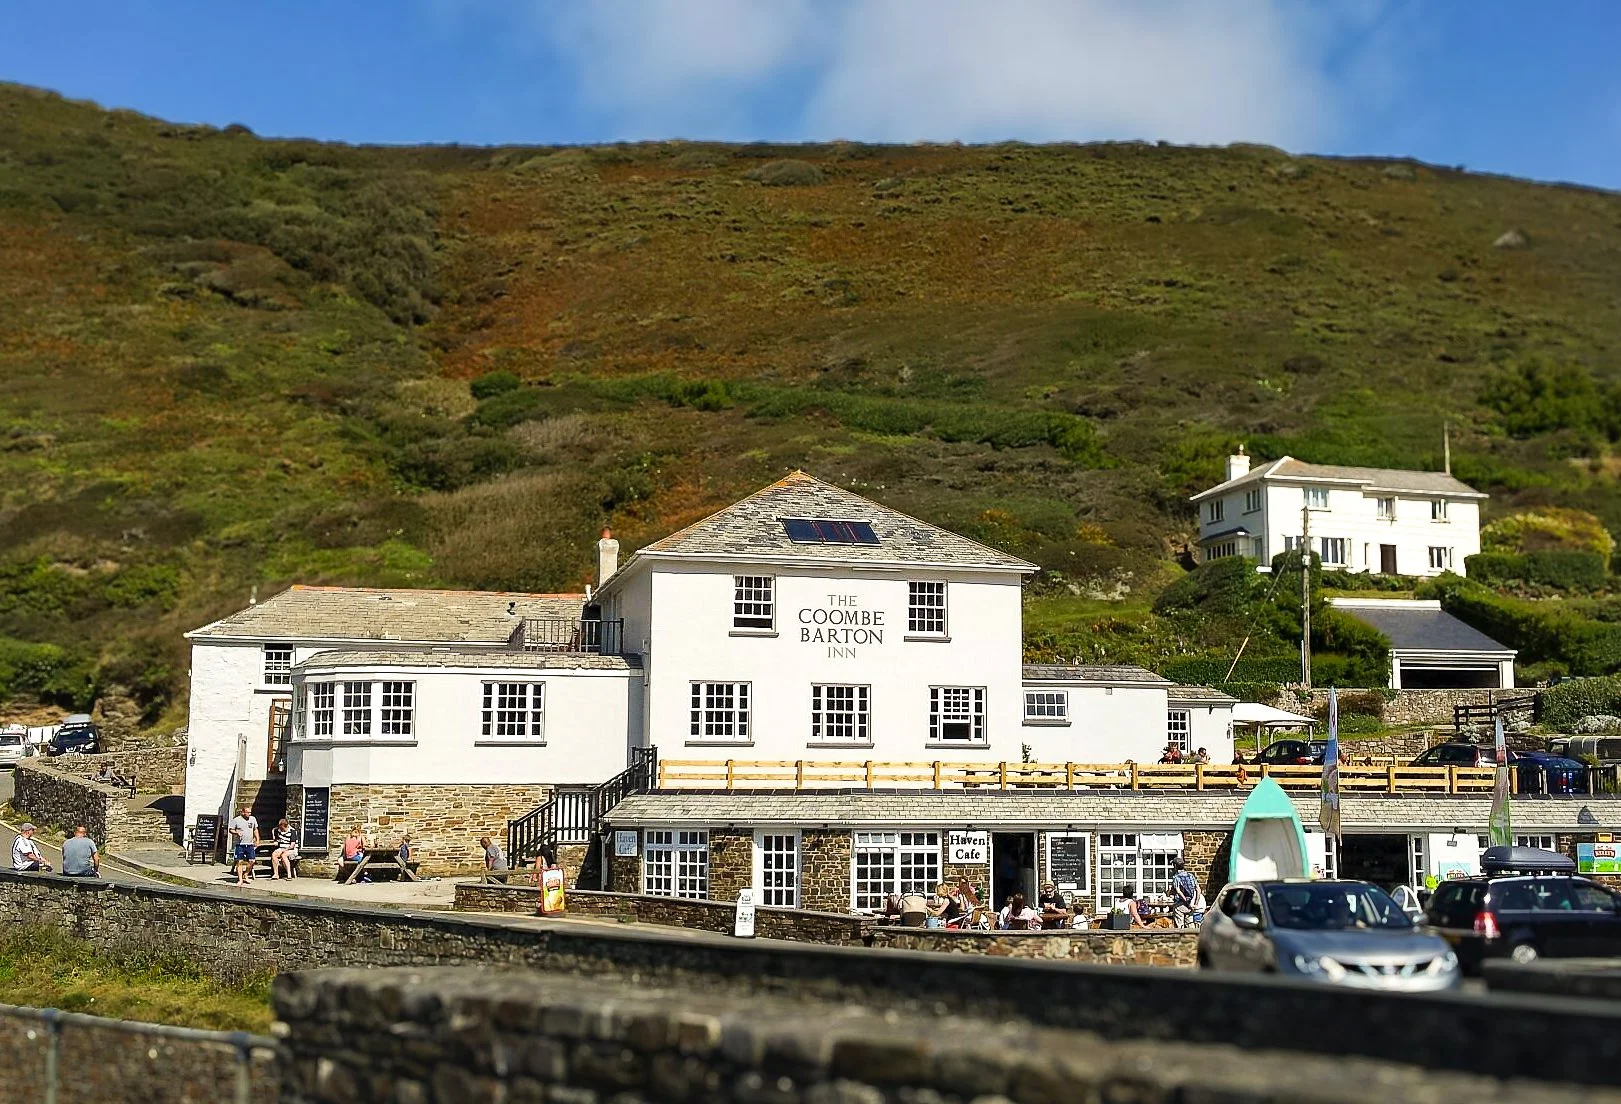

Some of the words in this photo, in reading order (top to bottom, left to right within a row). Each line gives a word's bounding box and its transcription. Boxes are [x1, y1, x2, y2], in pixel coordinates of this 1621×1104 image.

[826, 594, 858, 607] THE
[798, 608, 885, 626] COOMBE
[800, 627, 883, 645] BARTON
[827, 646, 856, 659] INN
[949, 834, 986, 846] Haven
[955, 848, 981, 860] Cafe
